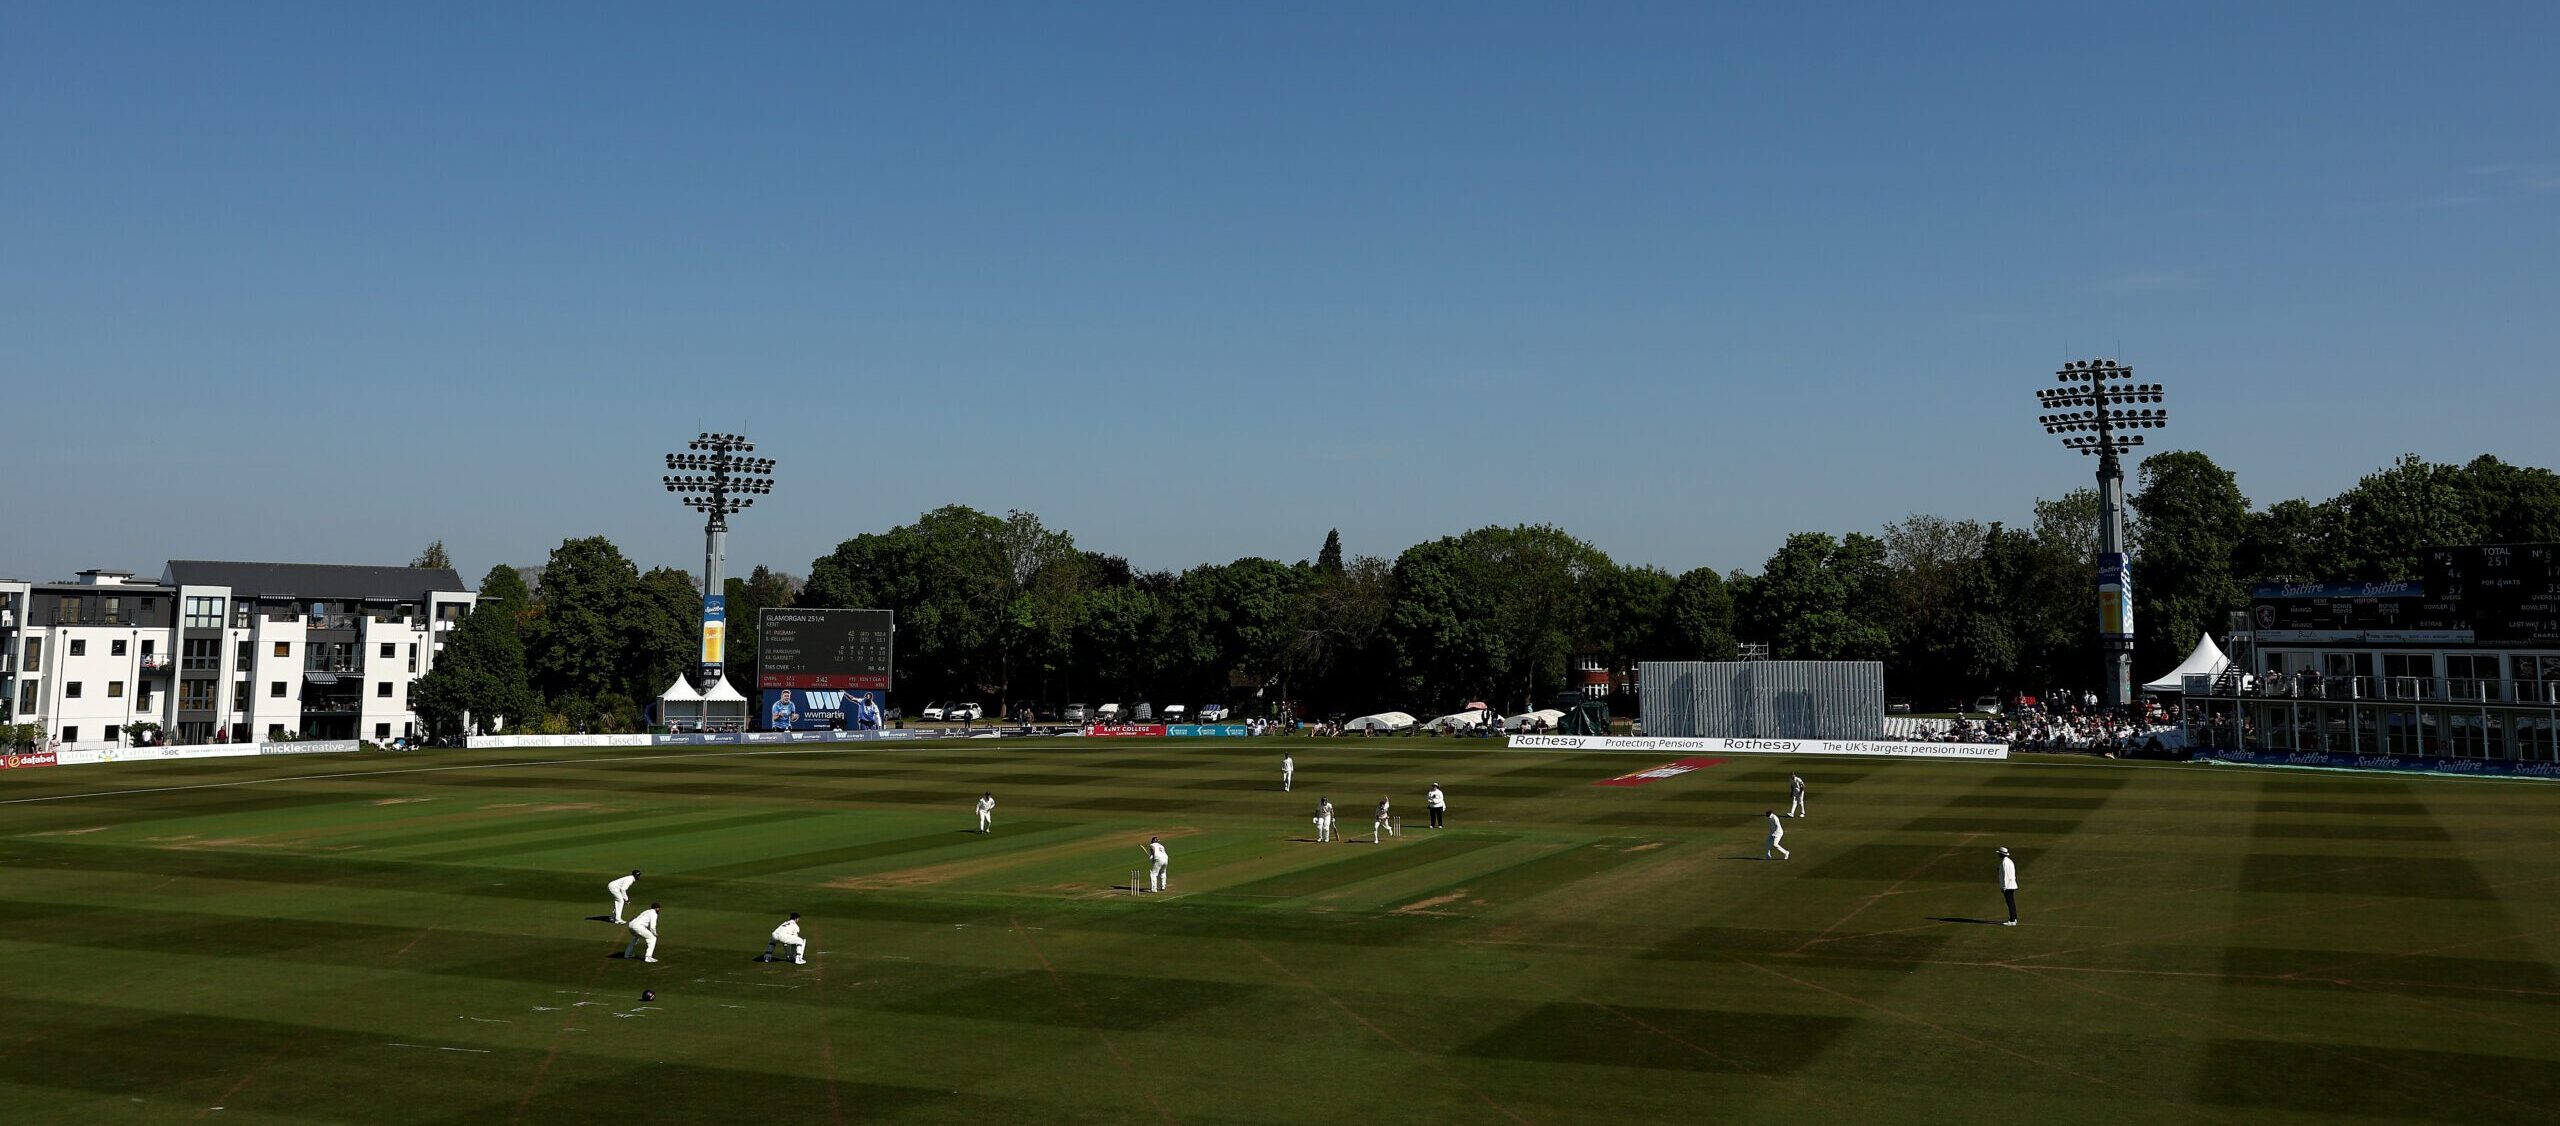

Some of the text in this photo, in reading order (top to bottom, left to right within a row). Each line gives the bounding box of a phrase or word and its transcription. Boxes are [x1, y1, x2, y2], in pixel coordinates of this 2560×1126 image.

[2483, 547, 2511, 556] TOTAL
[2281, 581, 2324, 597] Spitfire
[2362, 581, 2408, 596] Spitfire
[807, 615, 825, 623] 251/4
[804, 711, 845, 719] wwmartin
[468, 737, 505, 747] Tassells
[514, 736, 551, 747] Tassells
[561, 736, 598, 746] Tassells
[606, 735, 643, 746] Tassells
[1515, 735, 1999, 756] Rothesay Protecting Pensions Rothesay The UK's largest pension insurer
[20, 755, 56, 765] dafabet
[2285, 751, 2329, 765] Spitfire
[2354, 756, 2400, 769] Spitfire
[2434, 758, 2482, 773] Spitfire
